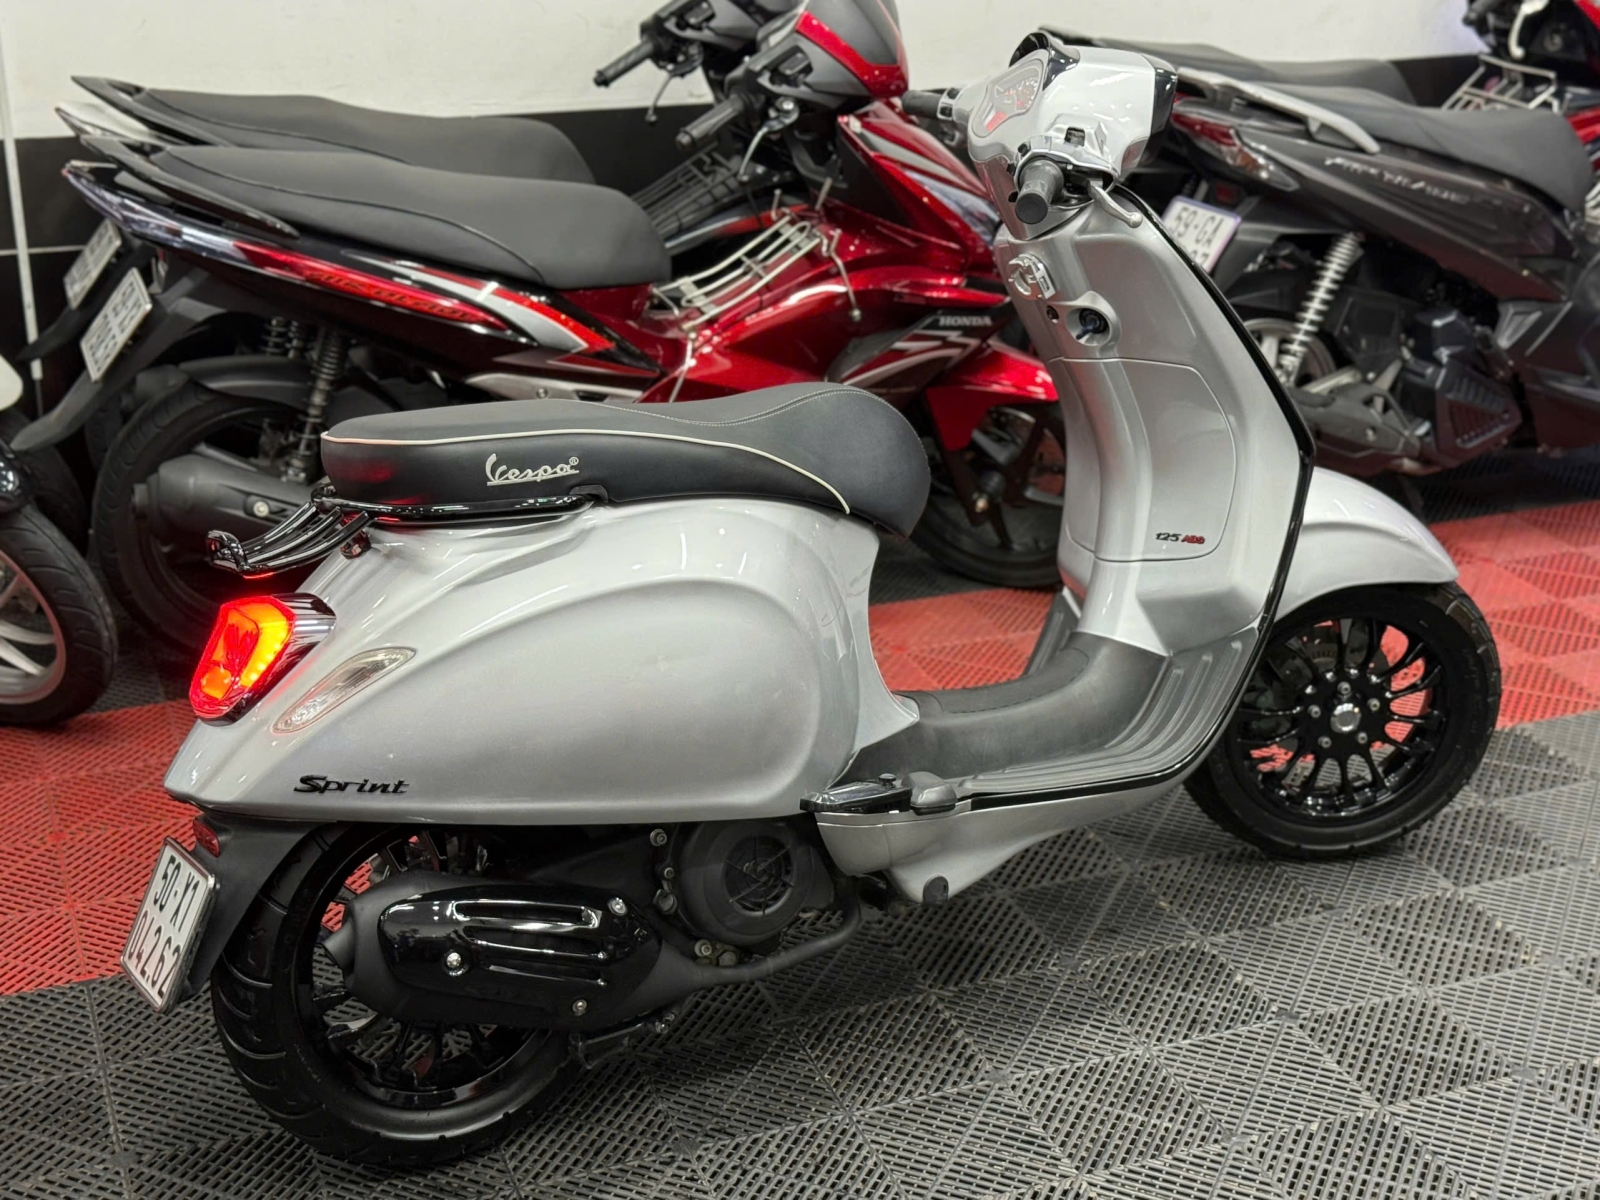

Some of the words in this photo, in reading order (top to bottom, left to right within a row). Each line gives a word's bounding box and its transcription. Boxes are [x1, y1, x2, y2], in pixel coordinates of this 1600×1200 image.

[938, 315, 993, 327] HONDA
[1155, 532, 1182, 542] 125
[1181, 534, 1206, 545] ABS
[293, 774, 410, 794] Sprint
[153, 853, 200, 933] 50-X1
[127, 909, 182, 1000] 042.62
